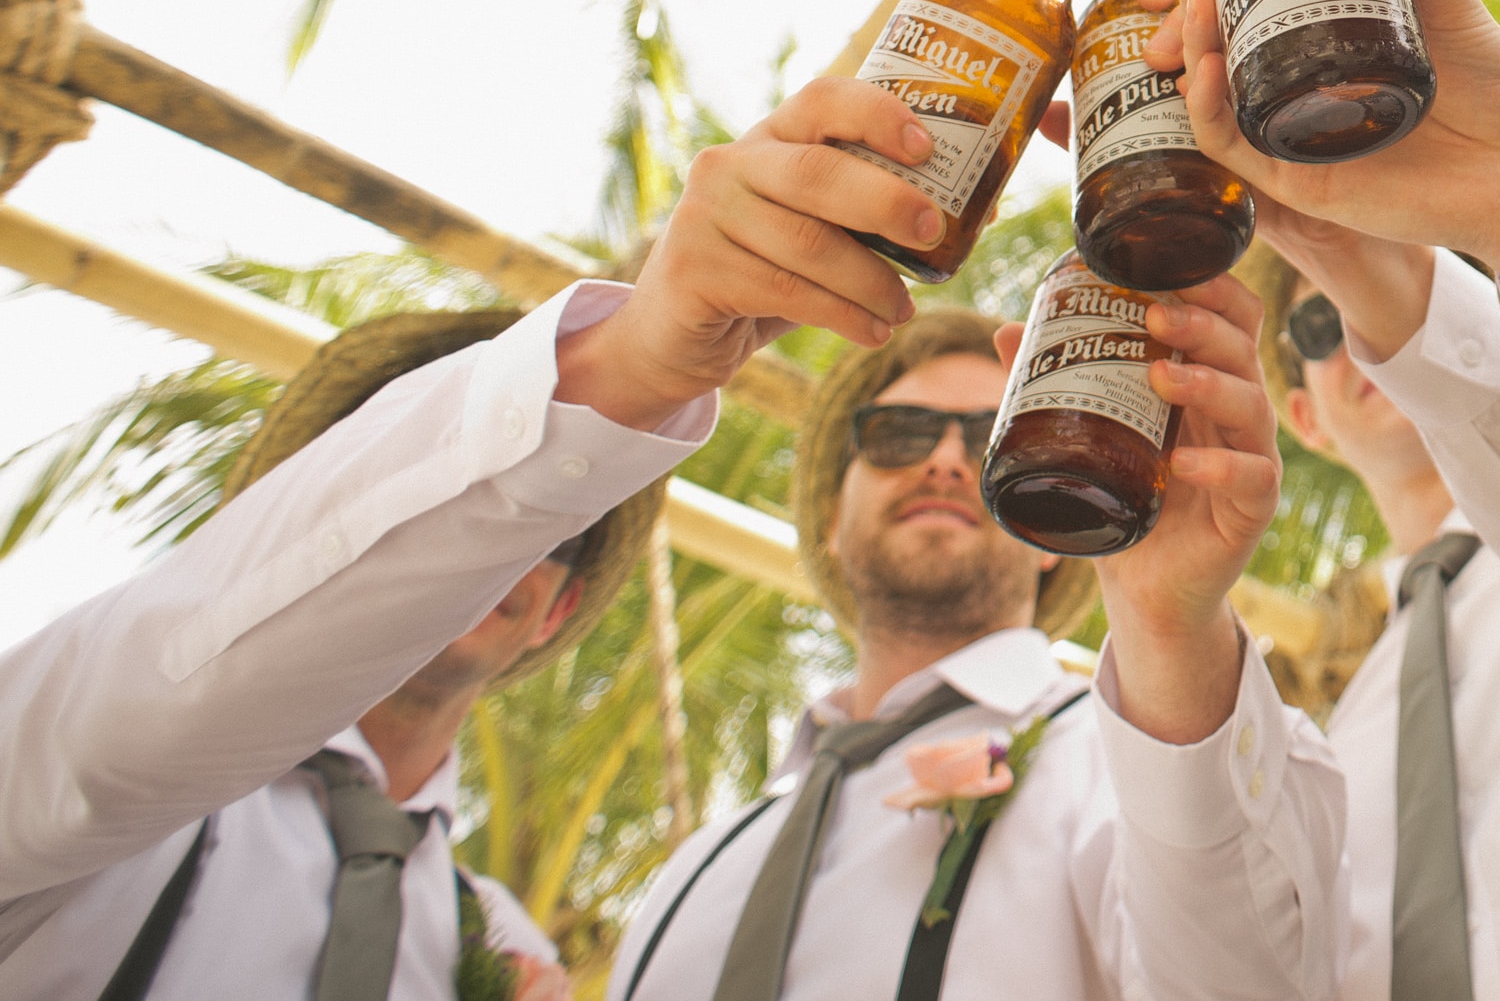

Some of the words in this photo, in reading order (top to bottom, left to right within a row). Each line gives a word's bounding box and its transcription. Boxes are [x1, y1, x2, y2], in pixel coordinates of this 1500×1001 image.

[886, 15, 1004, 88] Miguel
[1115, 72, 1132, 82] Beer
[1118, 72, 1175, 117] Pils
[1141, 113, 1159, 122] San
[1058, 286, 1146, 325] Migu
[1056, 334, 1146, 369] Pilsen
[1073, 371, 1092, 381] San
[1092, 373, 1123, 388] Miguel
